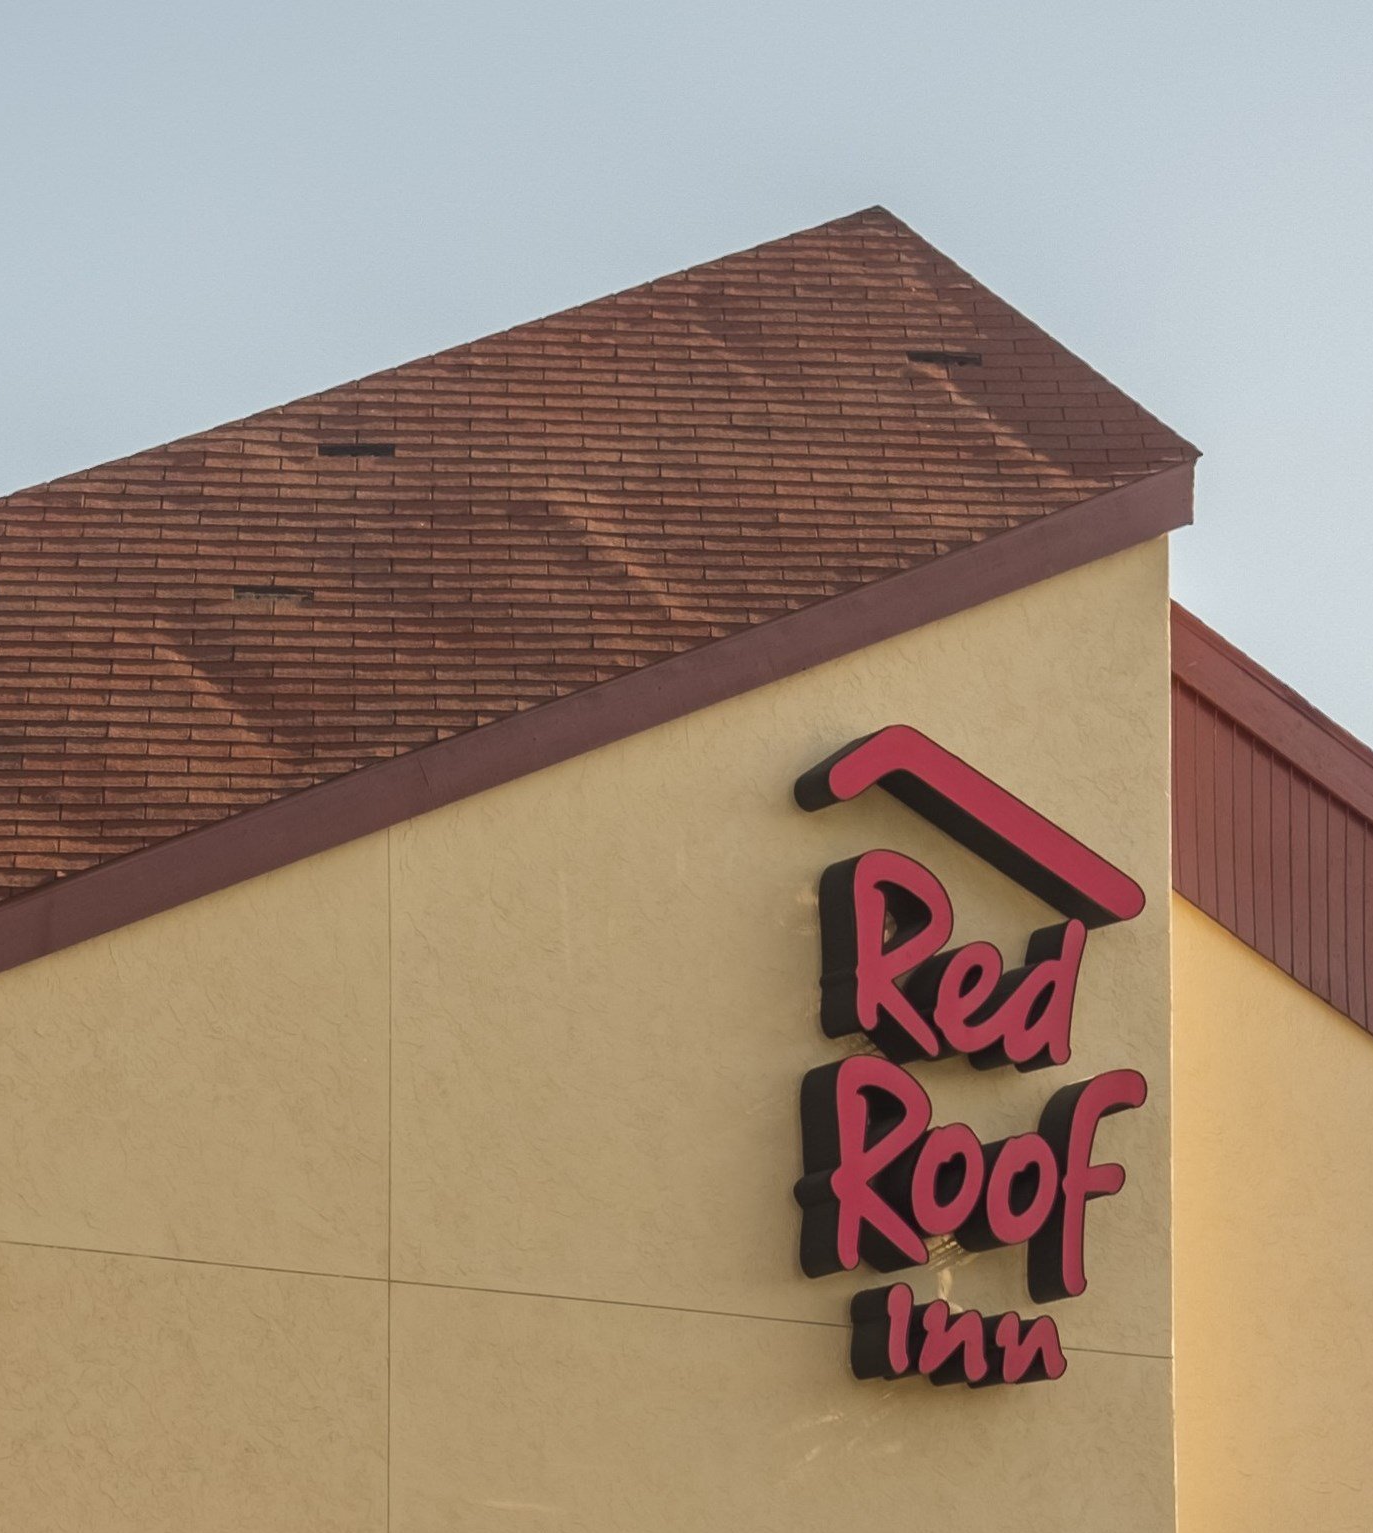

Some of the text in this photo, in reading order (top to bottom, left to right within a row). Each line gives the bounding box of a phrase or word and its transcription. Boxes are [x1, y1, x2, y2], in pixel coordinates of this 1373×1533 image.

[852, 848, 1088, 1066] Red
[830, 1053, 1149, 1299] Roof
[886, 1282, 1068, 1384] Inn
